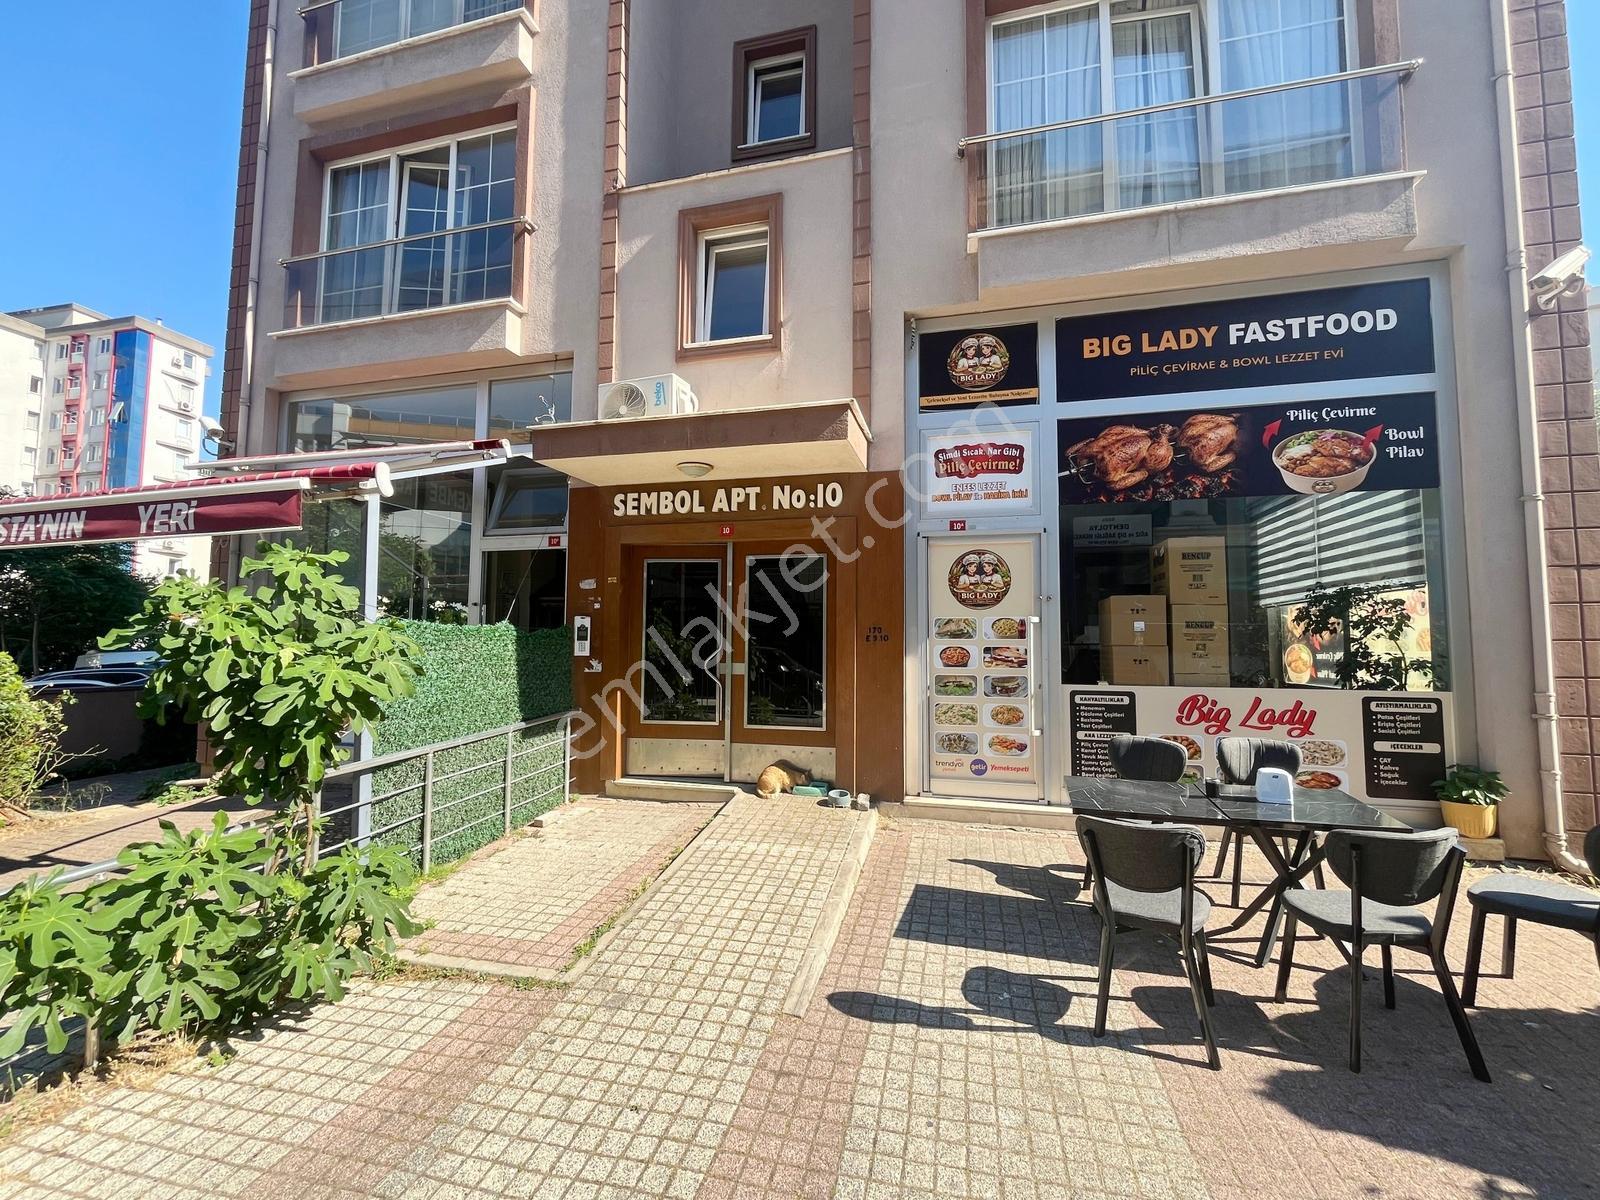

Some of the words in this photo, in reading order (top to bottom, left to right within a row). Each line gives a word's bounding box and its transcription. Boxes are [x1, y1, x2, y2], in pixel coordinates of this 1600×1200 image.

[1082, 335, 1132, 359] BIG
[1141, 325, 1219, 354] LADY
[1229, 308, 1398, 345] FASTFOOD
[1130, 364, 1158, 377] PİLİÇ
[1162, 358, 1216, 374] ÇEVİRME
[1220, 360, 1229, 369] &
[1232, 356, 1272, 369] BOWL
[1275, 350, 1319, 364] LEZZET
[1324, 347, 1345, 360] EVİ
[975, 373, 997, 381] LADY
[1286, 409, 1319, 423] Piliç
[1321, 406, 1377, 422] Çevirme
[1385, 426, 1424, 441] Bowl
[938, 450, 961, 462] Şimdi
[987, 447, 1001, 455] Nar
[1003, 447, 1020, 457] Gibi
[1385, 445, 1425, 459] Pilav
[939, 460, 966, 475] Piliç
[968, 459, 1020, 474] Çevirme!
[952, 482, 976, 492] ENFES
[978, 481, 1007, 491] LEZZET
[613, 489, 706, 517] SEMBOL
[772, 482, 844, 510] No:10
[1176, 694, 1232, 735] Big
[1239, 696, 1317, 738] Lady
[935, 760, 964, 769] trendyol
[970, 763, 987, 771] getir
[990, 764, 1030, 773] Yemeksepeti
